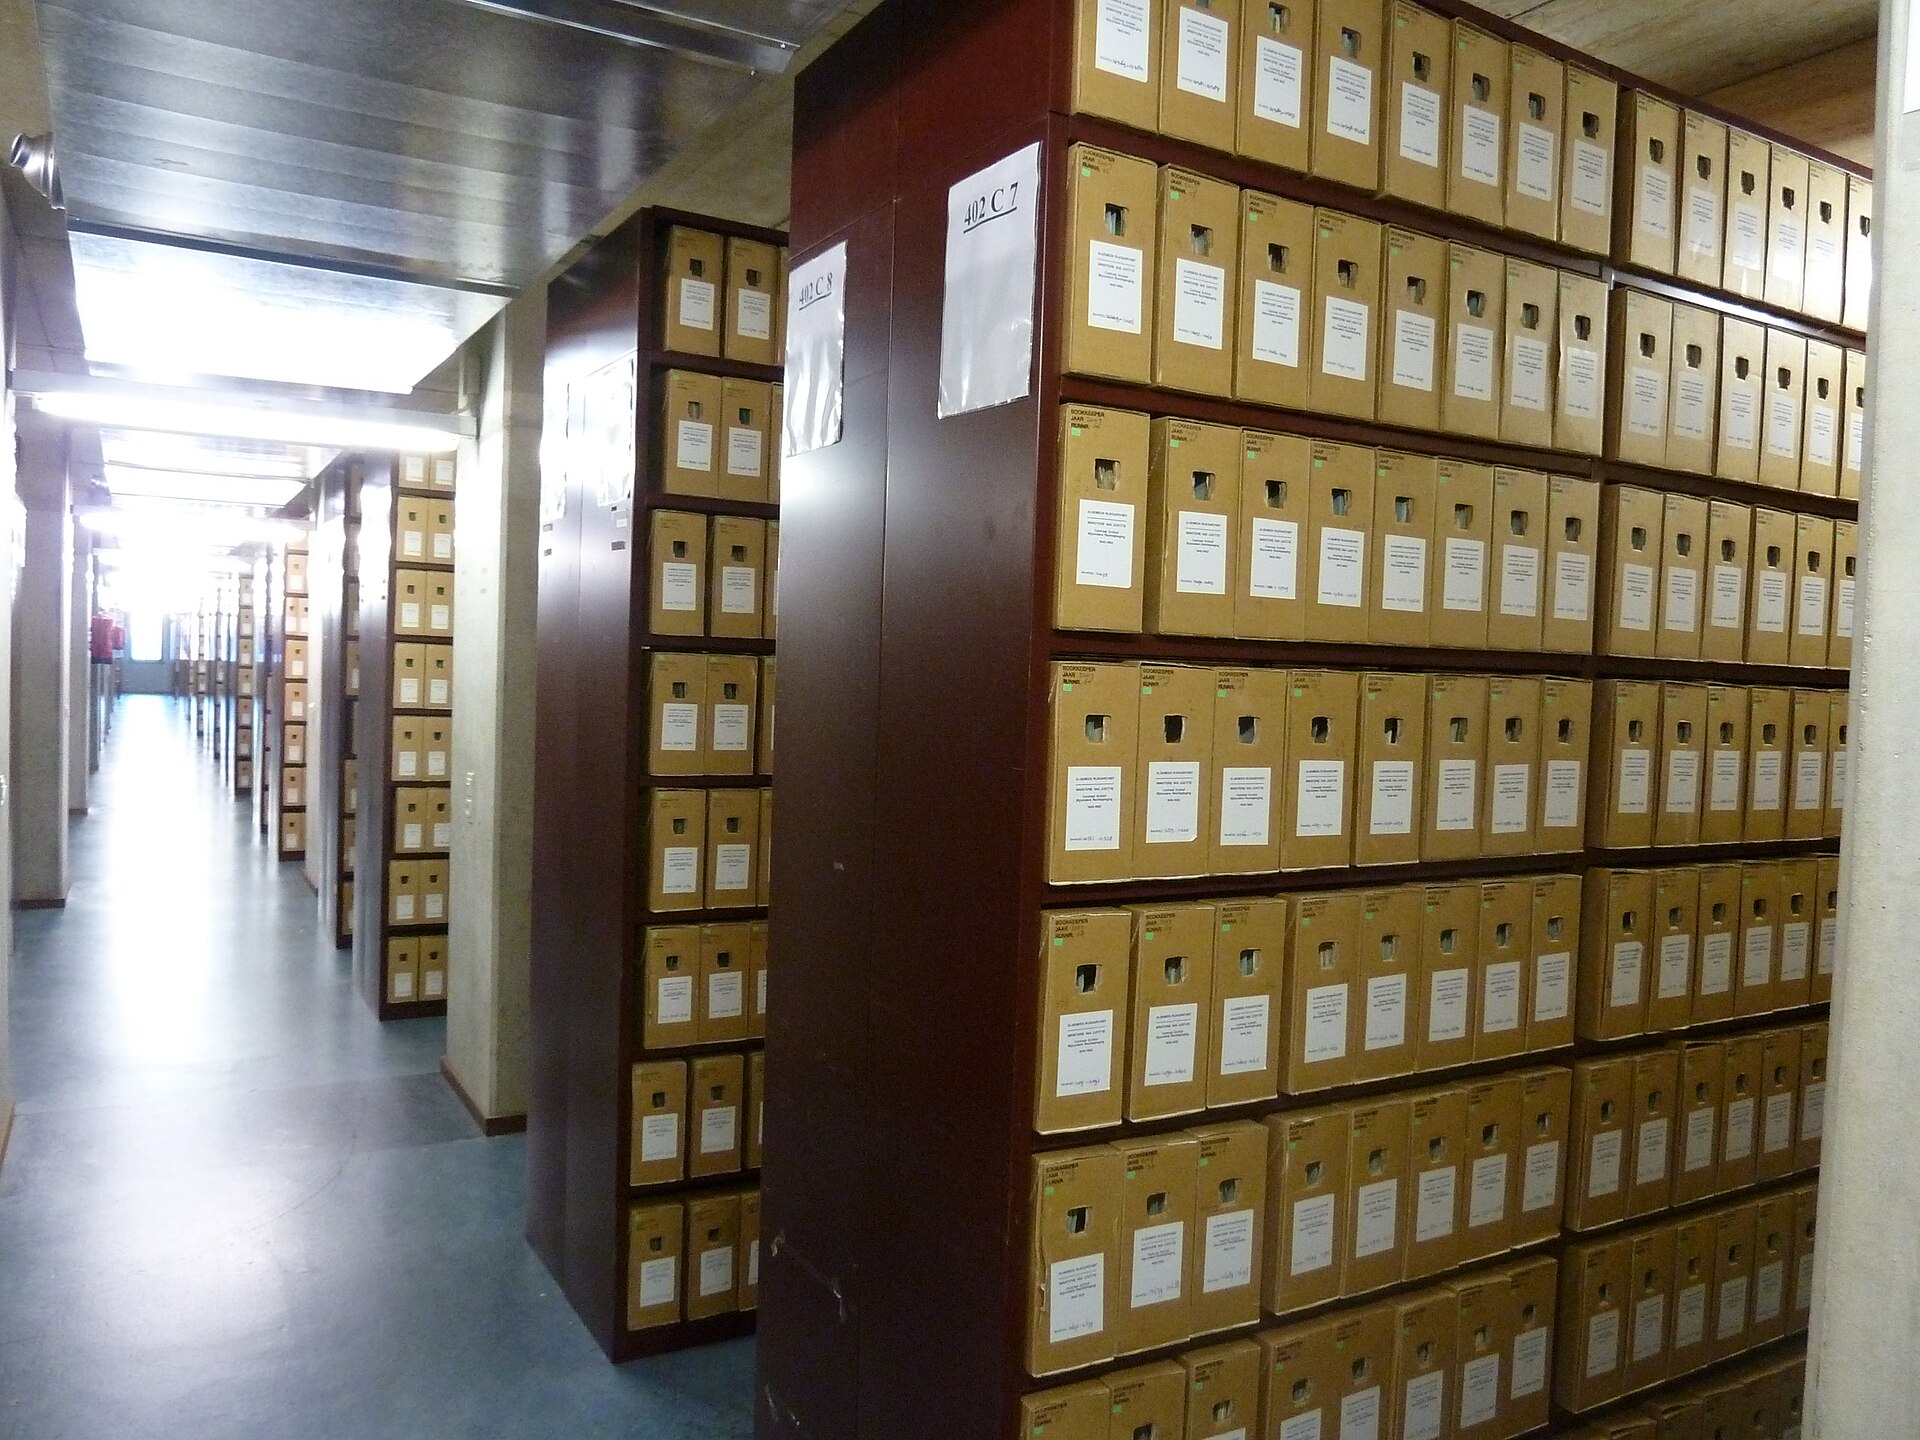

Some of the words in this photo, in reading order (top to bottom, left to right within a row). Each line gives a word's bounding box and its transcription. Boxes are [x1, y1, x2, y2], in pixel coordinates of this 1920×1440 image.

[964, 196, 985, 225] 402
[991, 188, 1004, 212] C
[1010, 181, 1018, 206] 7
[799, 282, 813, 304] 402
[816, 276, 824, 295] C
[827, 272, 832, 291] 8
[1071, 409, 1104, 417] BOOKKEEPER
